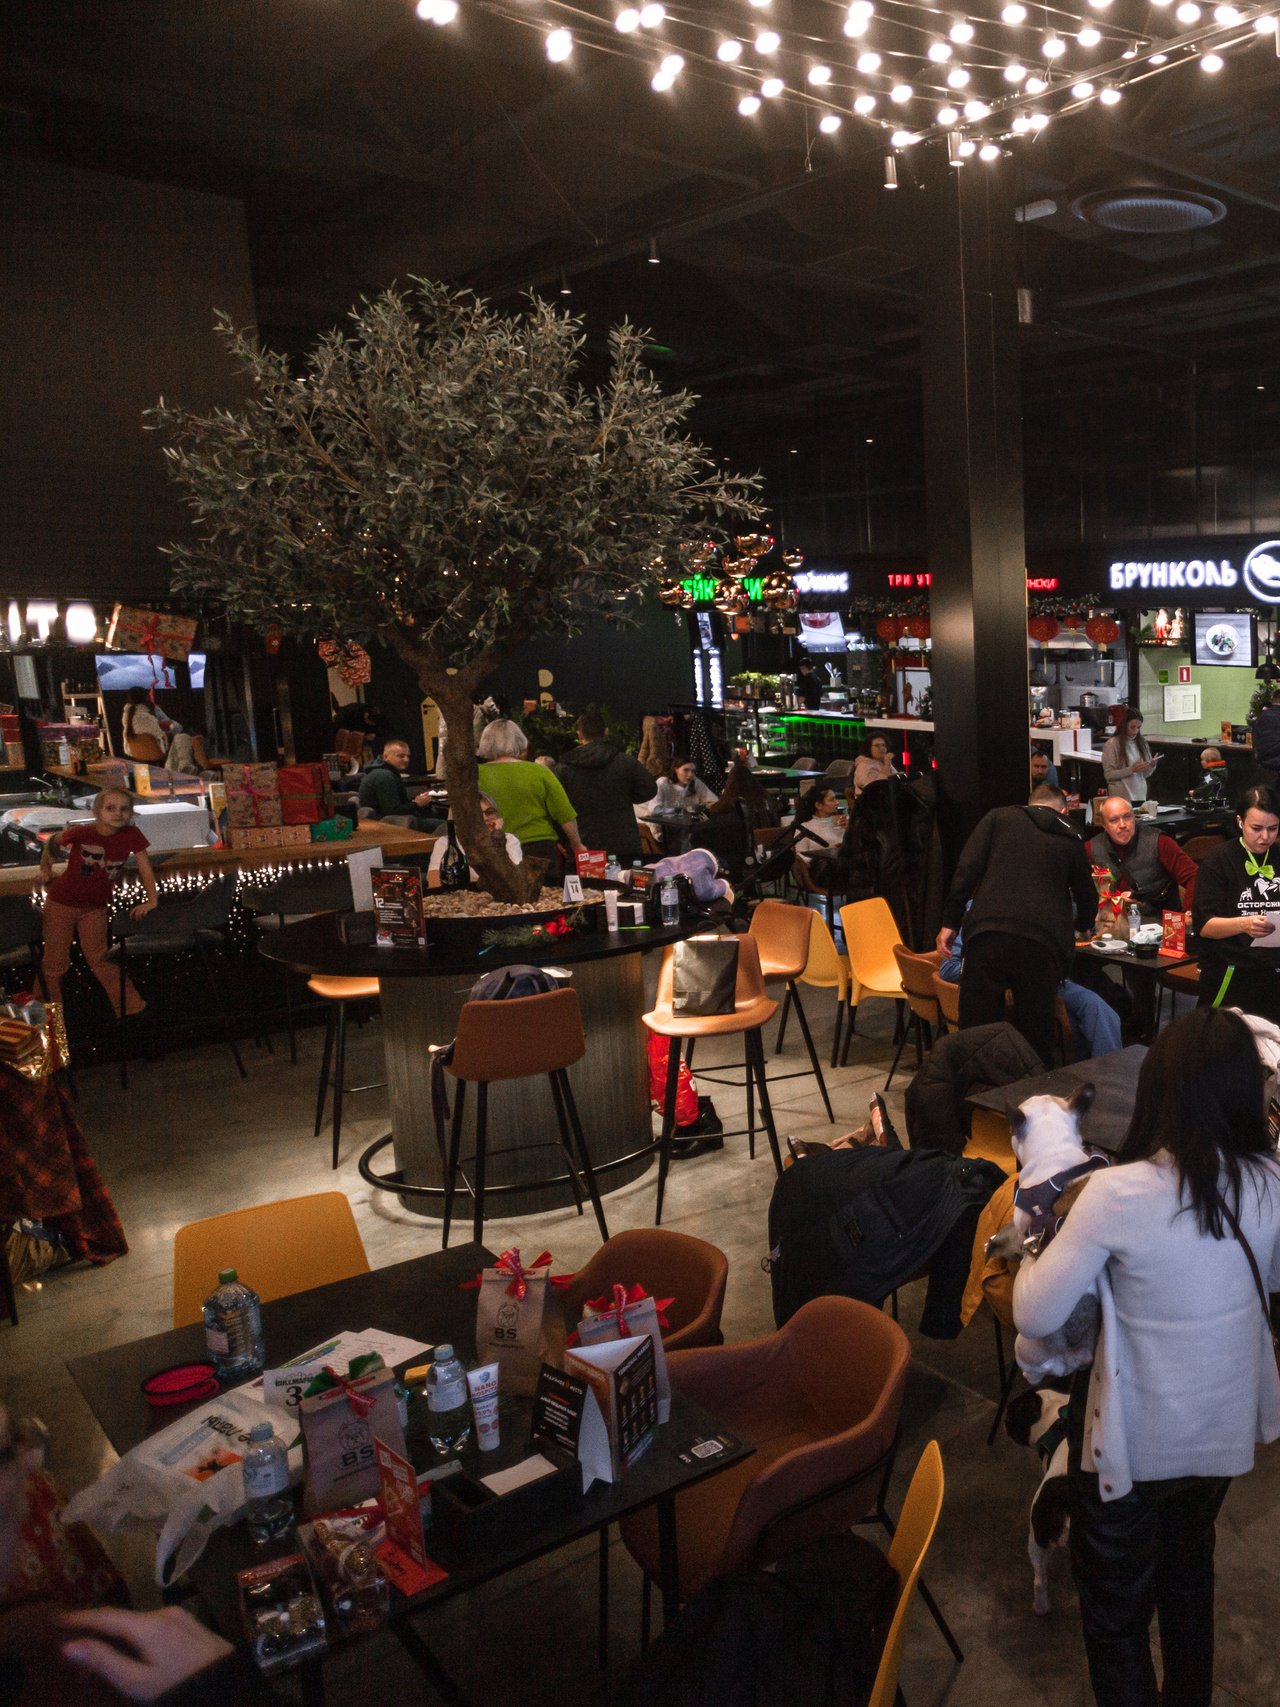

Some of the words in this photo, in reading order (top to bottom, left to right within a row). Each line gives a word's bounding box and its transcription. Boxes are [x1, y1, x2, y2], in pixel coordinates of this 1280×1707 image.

[888, 574, 912, 587] ТРИ
[1111, 559, 1238, 590] БРУНКОЛЬ
[374, 898, 384, 908] 12
[494, 1327, 517, 1339] BS
[474, 1381, 497, 1391] NANO
[285, 1386, 303, 1406] 3
[342, 1445, 375, 1466] BS
